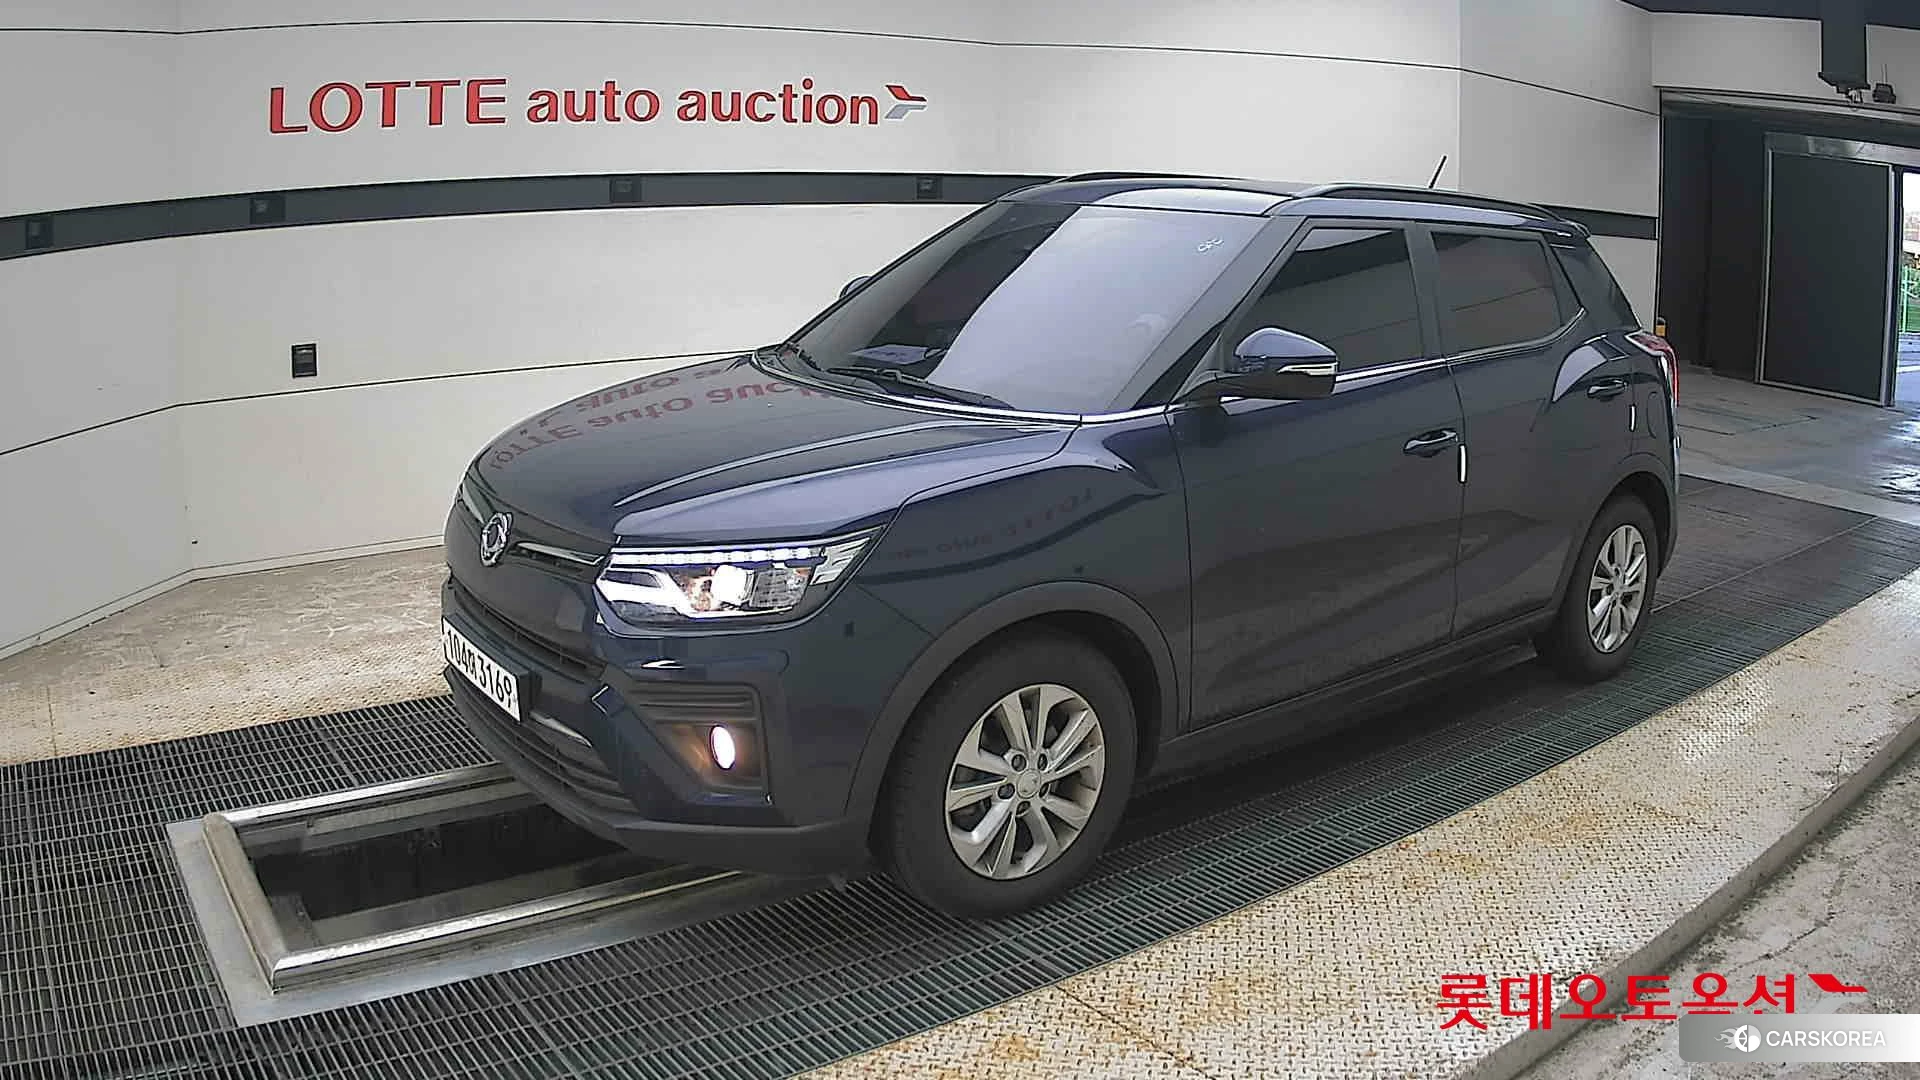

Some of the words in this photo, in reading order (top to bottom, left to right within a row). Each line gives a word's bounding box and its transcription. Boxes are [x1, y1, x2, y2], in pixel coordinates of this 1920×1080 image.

[269, 78, 507, 134] LOTTE
[527, 80, 662, 124] auto
[677, 78, 879, 125] auction
